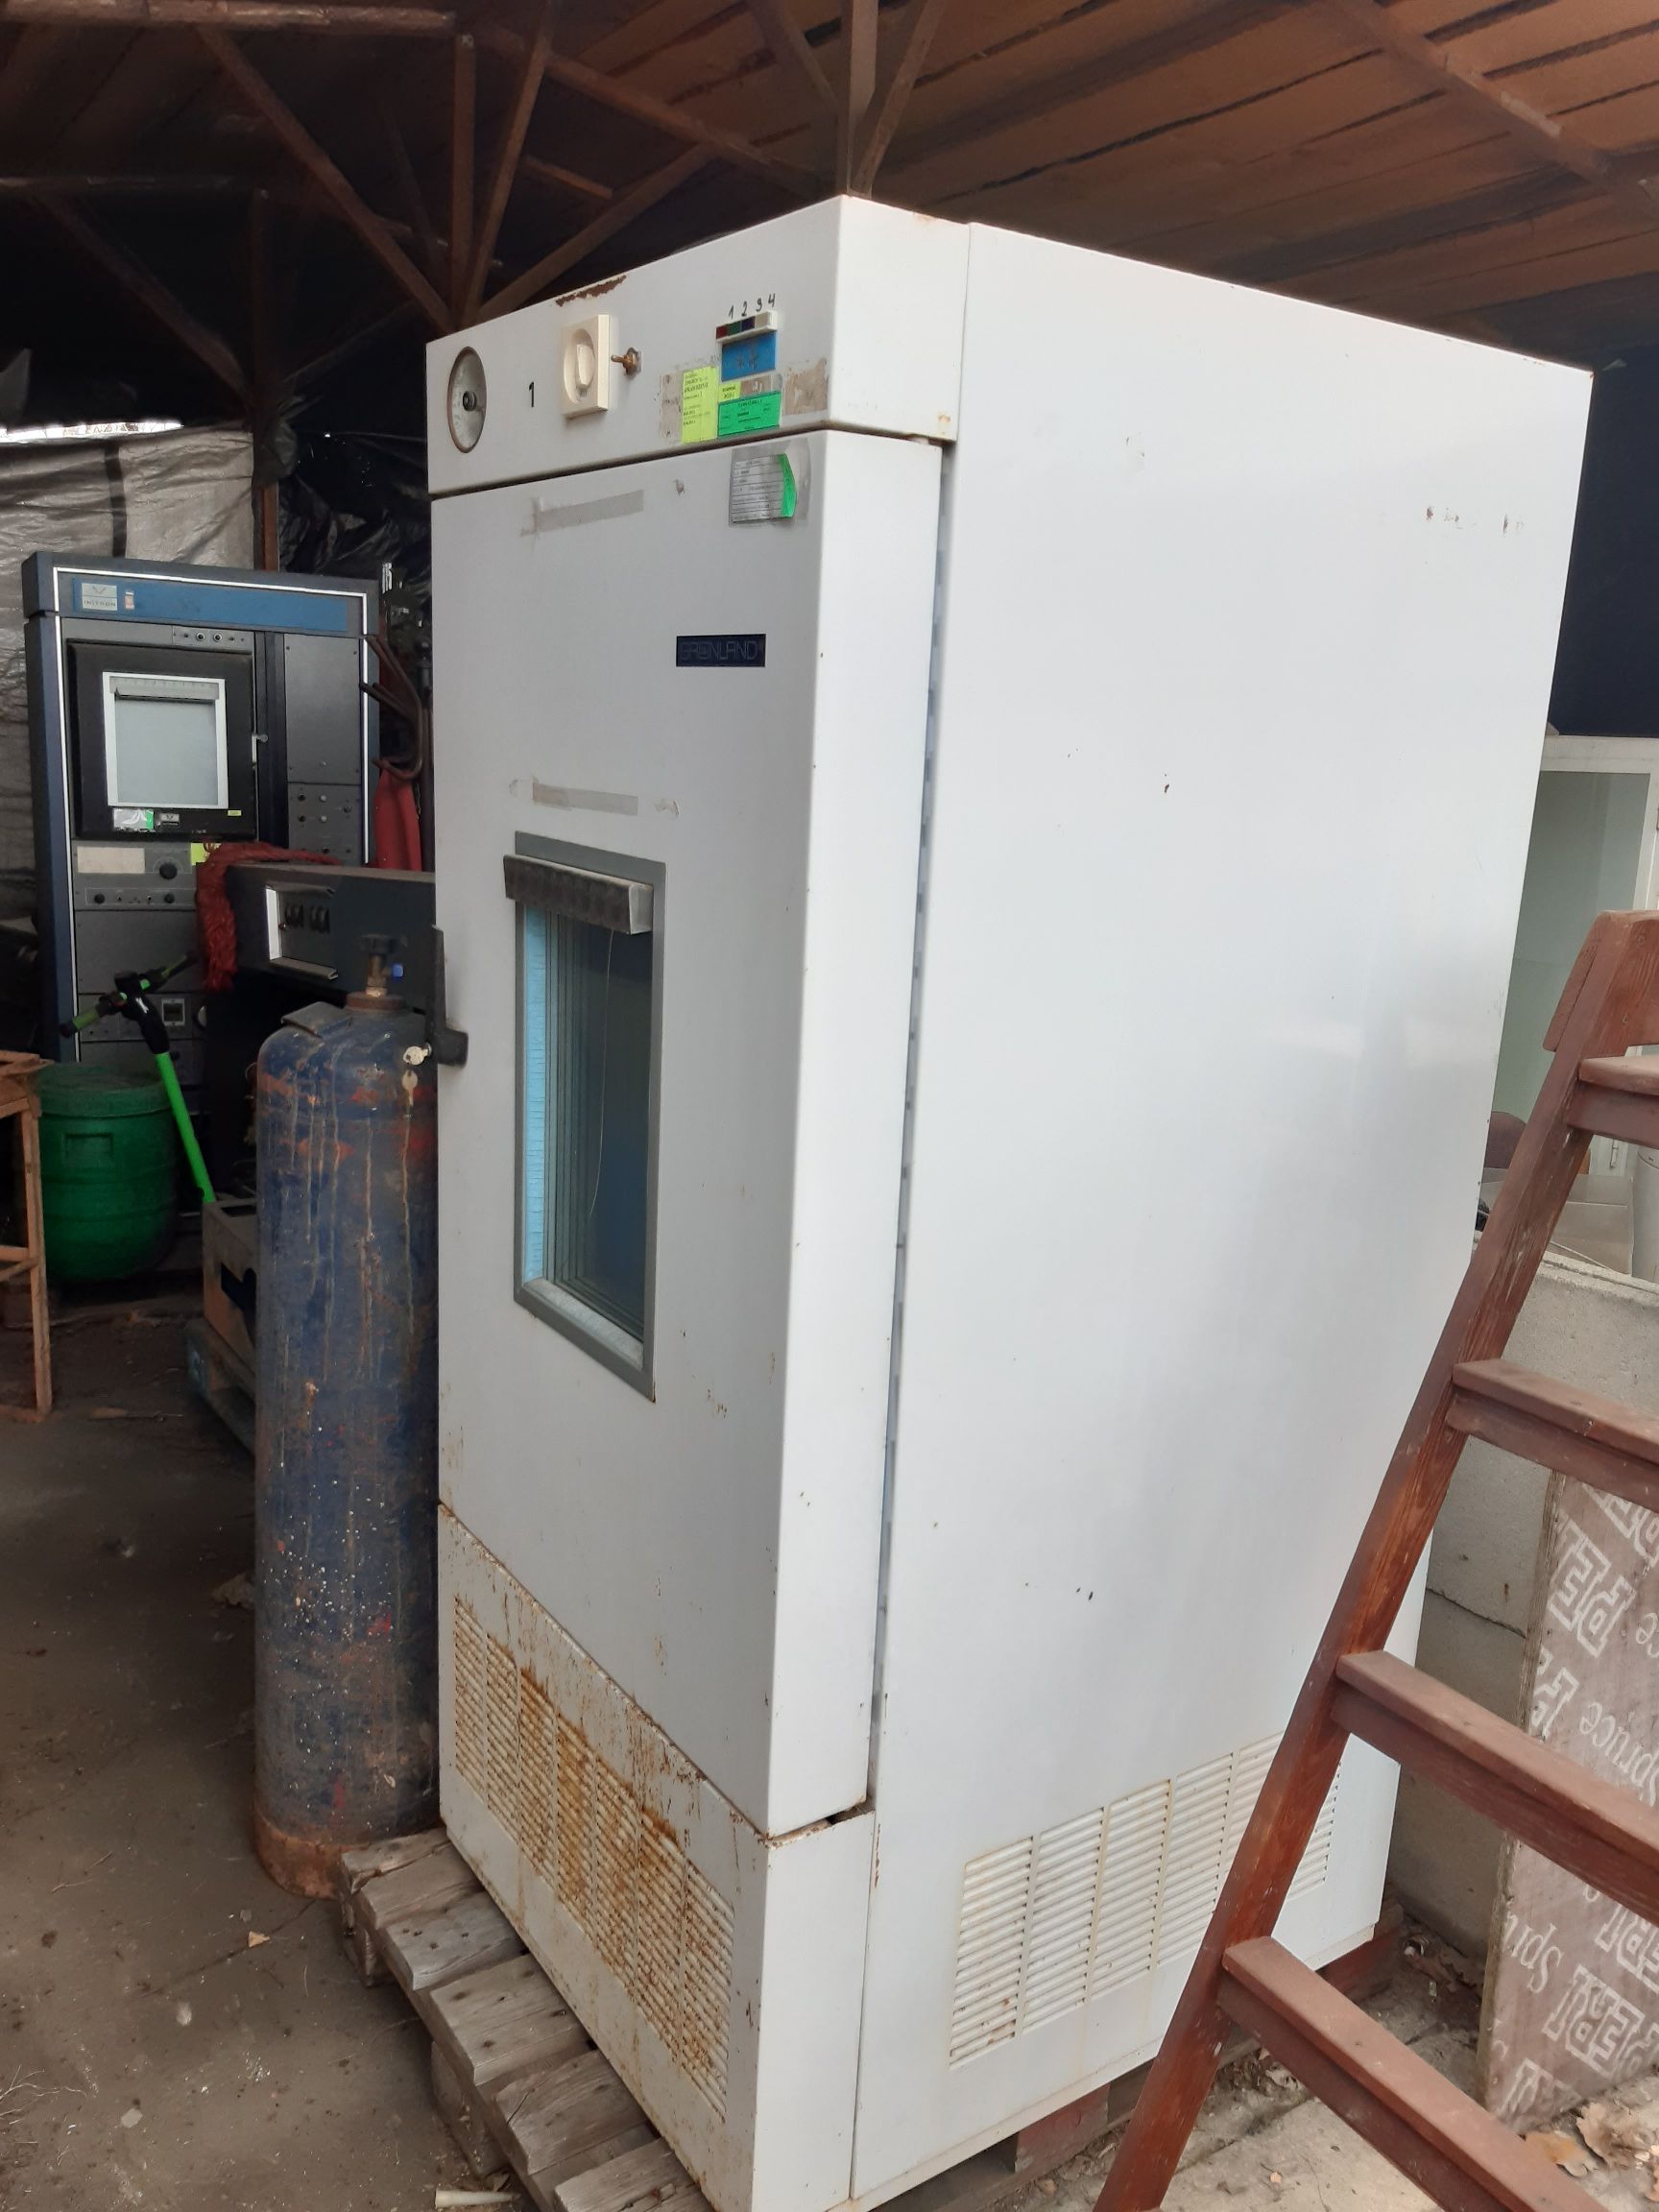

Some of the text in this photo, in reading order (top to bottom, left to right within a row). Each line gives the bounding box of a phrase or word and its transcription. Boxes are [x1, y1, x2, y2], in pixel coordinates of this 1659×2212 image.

[727, 303, 735, 321] 1
[740, 301, 749, 317] 2
[767, 292, 777, 308] 4
[528, 381, 536, 408] 1
